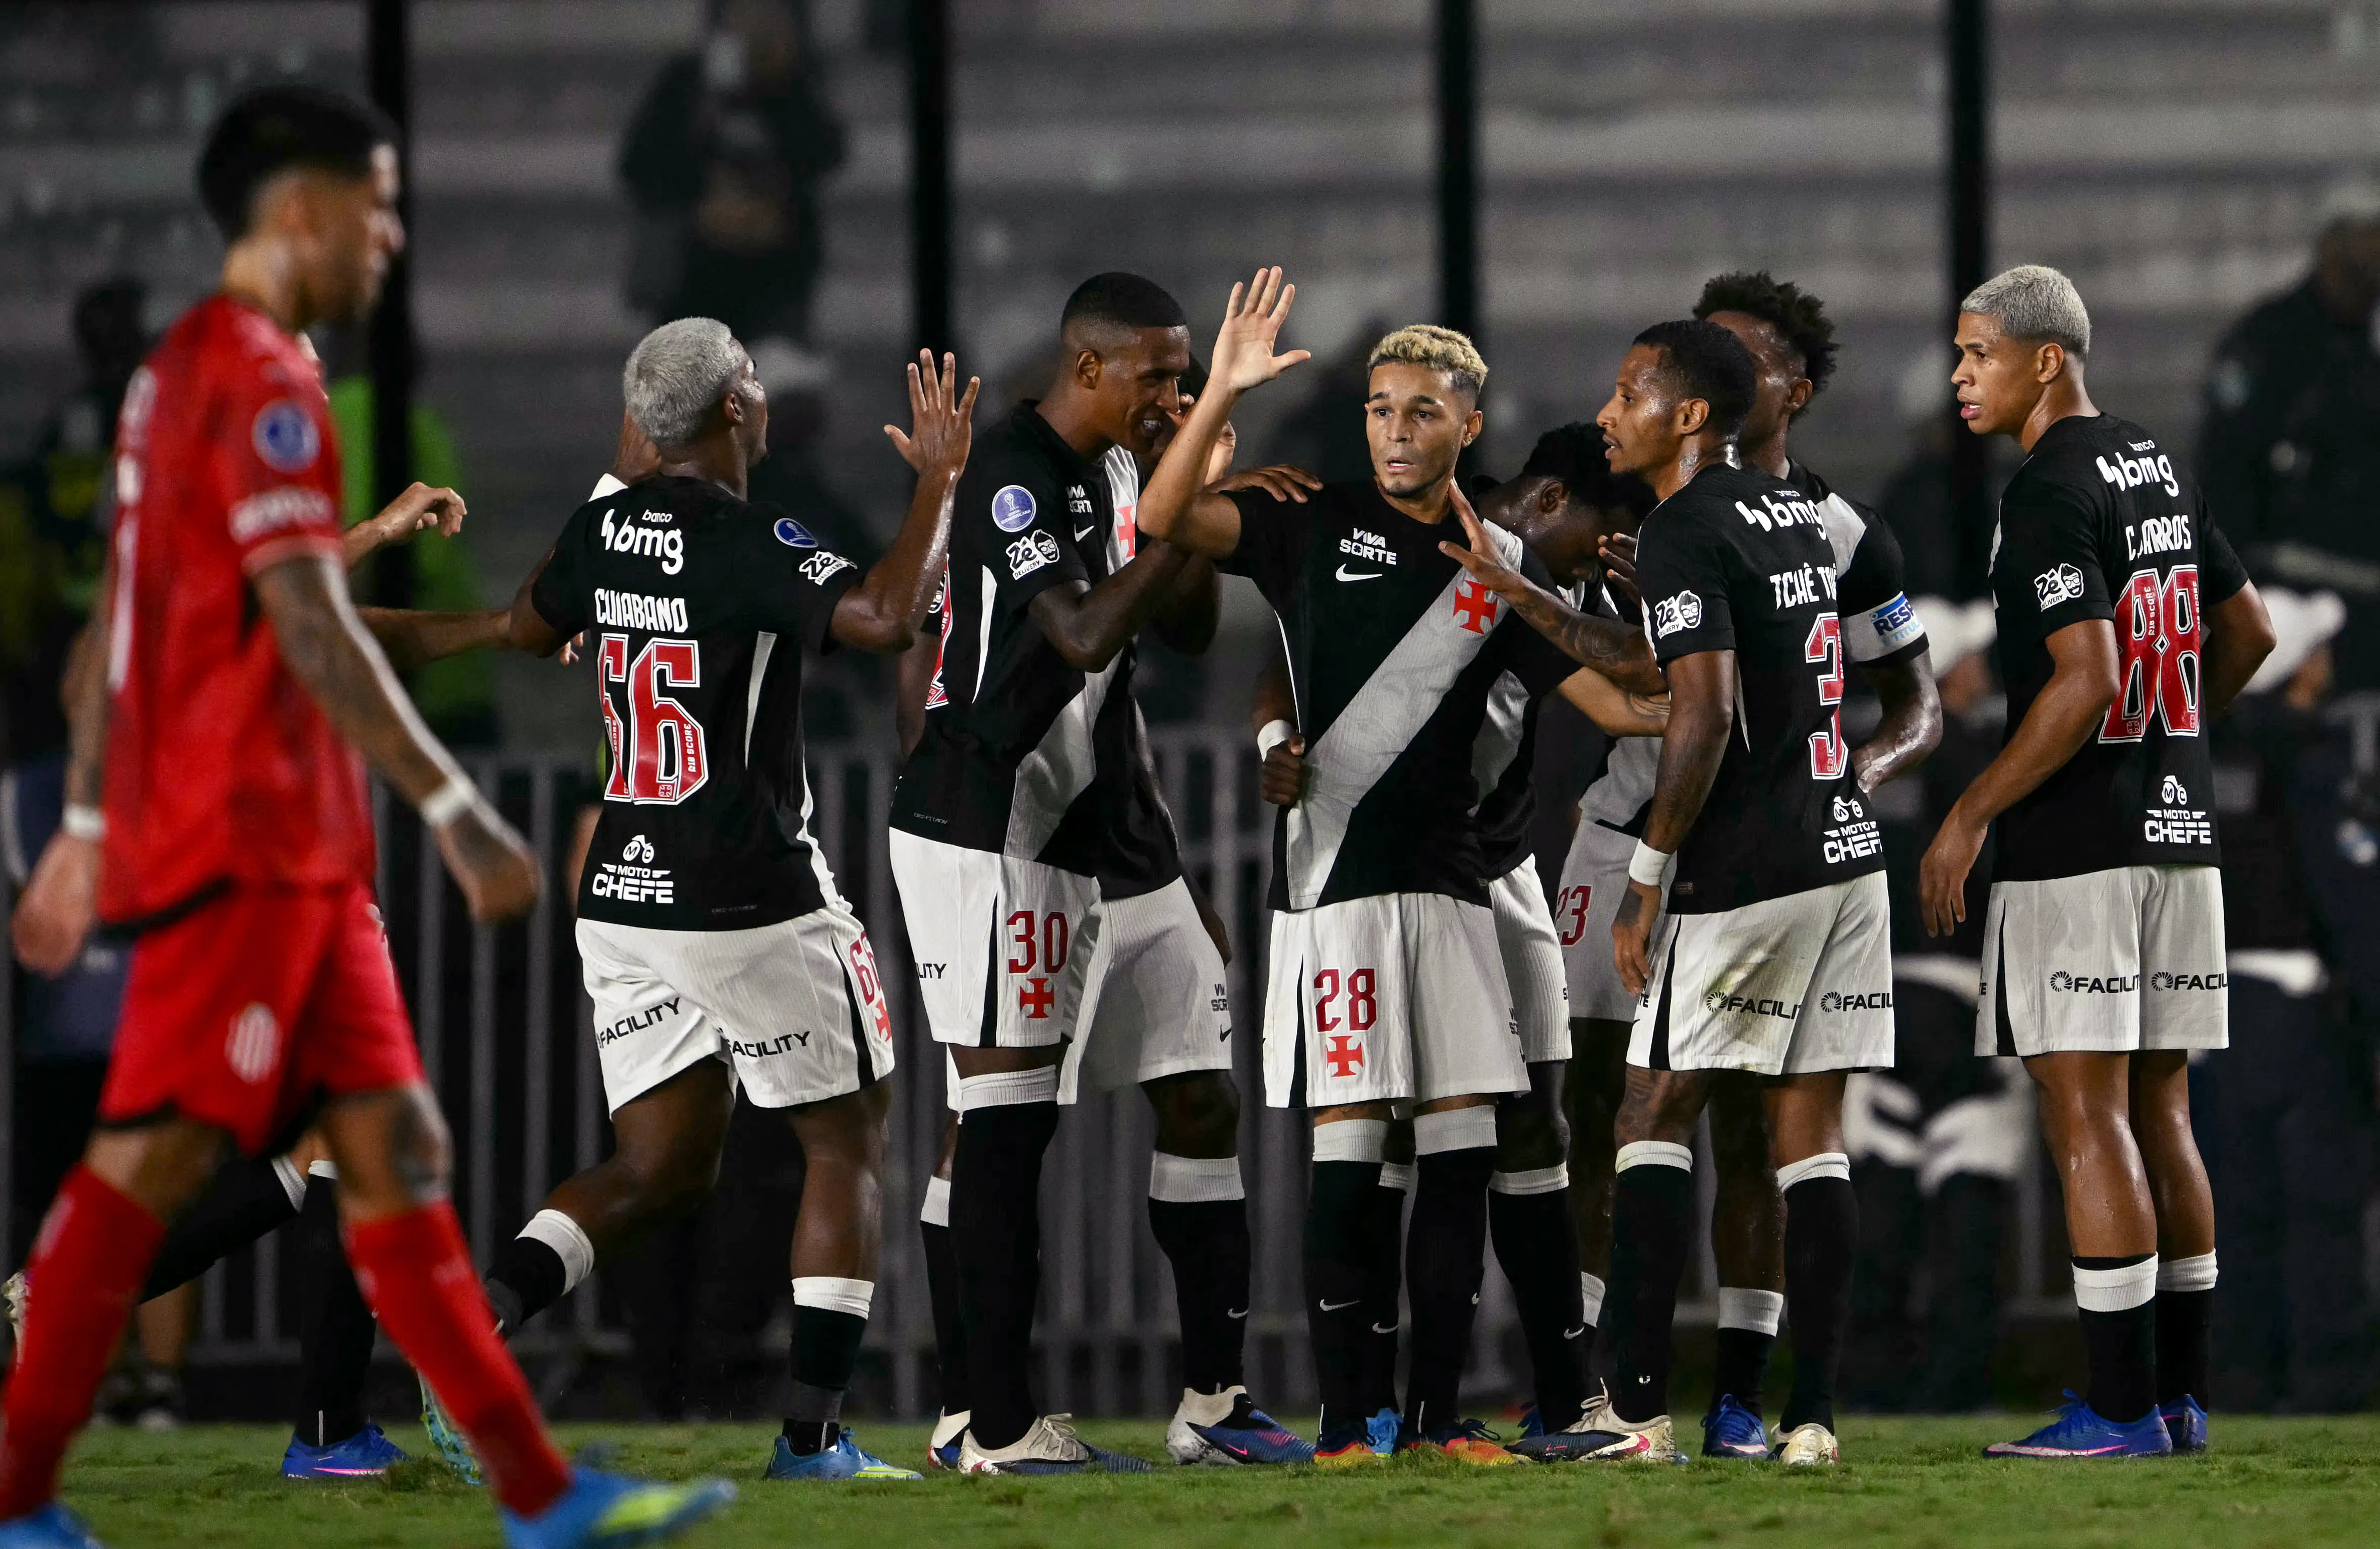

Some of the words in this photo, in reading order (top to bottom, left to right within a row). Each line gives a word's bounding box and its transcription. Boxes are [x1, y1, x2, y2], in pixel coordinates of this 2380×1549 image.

[2128, 440, 2155, 451] banco
[2115, 452, 2179, 497] bmg
[641, 509, 673, 522] banco
[614, 515, 683, 575] bmg
[1353, 527, 1386, 548] VIVA
[2139, 515, 2192, 557] ARROS
[1008, 540, 1037, 570] Zé
[1339, 539, 1397, 565] SORTE
[1015, 560, 1041, 578] DELIVERY
[1769, 562, 1820, 610] TCHÊ
[2036, 571, 2062, 602] Zé
[594, 588, 688, 633] CUIABANO
[1656, 600, 1678, 629] Zé
[1873, 602, 1914, 636] RESP
[2098, 564, 2200, 744] 88
[1805, 612, 1849, 780] 3
[598, 633, 708, 805] 66
[683, 724, 694, 755] SCORE
[1840, 821, 1871, 837] MOTO
[2163, 809, 2190, 820] MOTO
[2145, 820, 2212, 844] CHEFE
[1823, 831, 1883, 864] CHEF
[617, 865, 650, 879] MOTO
[592, 873, 674, 904] CHEFE
[1006, 910, 1068, 974] 30
[2074, 974, 2139, 994] FACILIT
[2174, 973, 2227, 990] FACIL
[1313, 968, 1377, 1032] 28
[1727, 997, 1801, 1020] FACILI
[1843, 992, 1892, 1011] FACIL
[599, 997, 680, 1049] FACILITY
[728, 1031, 810, 1058] ACILITY
